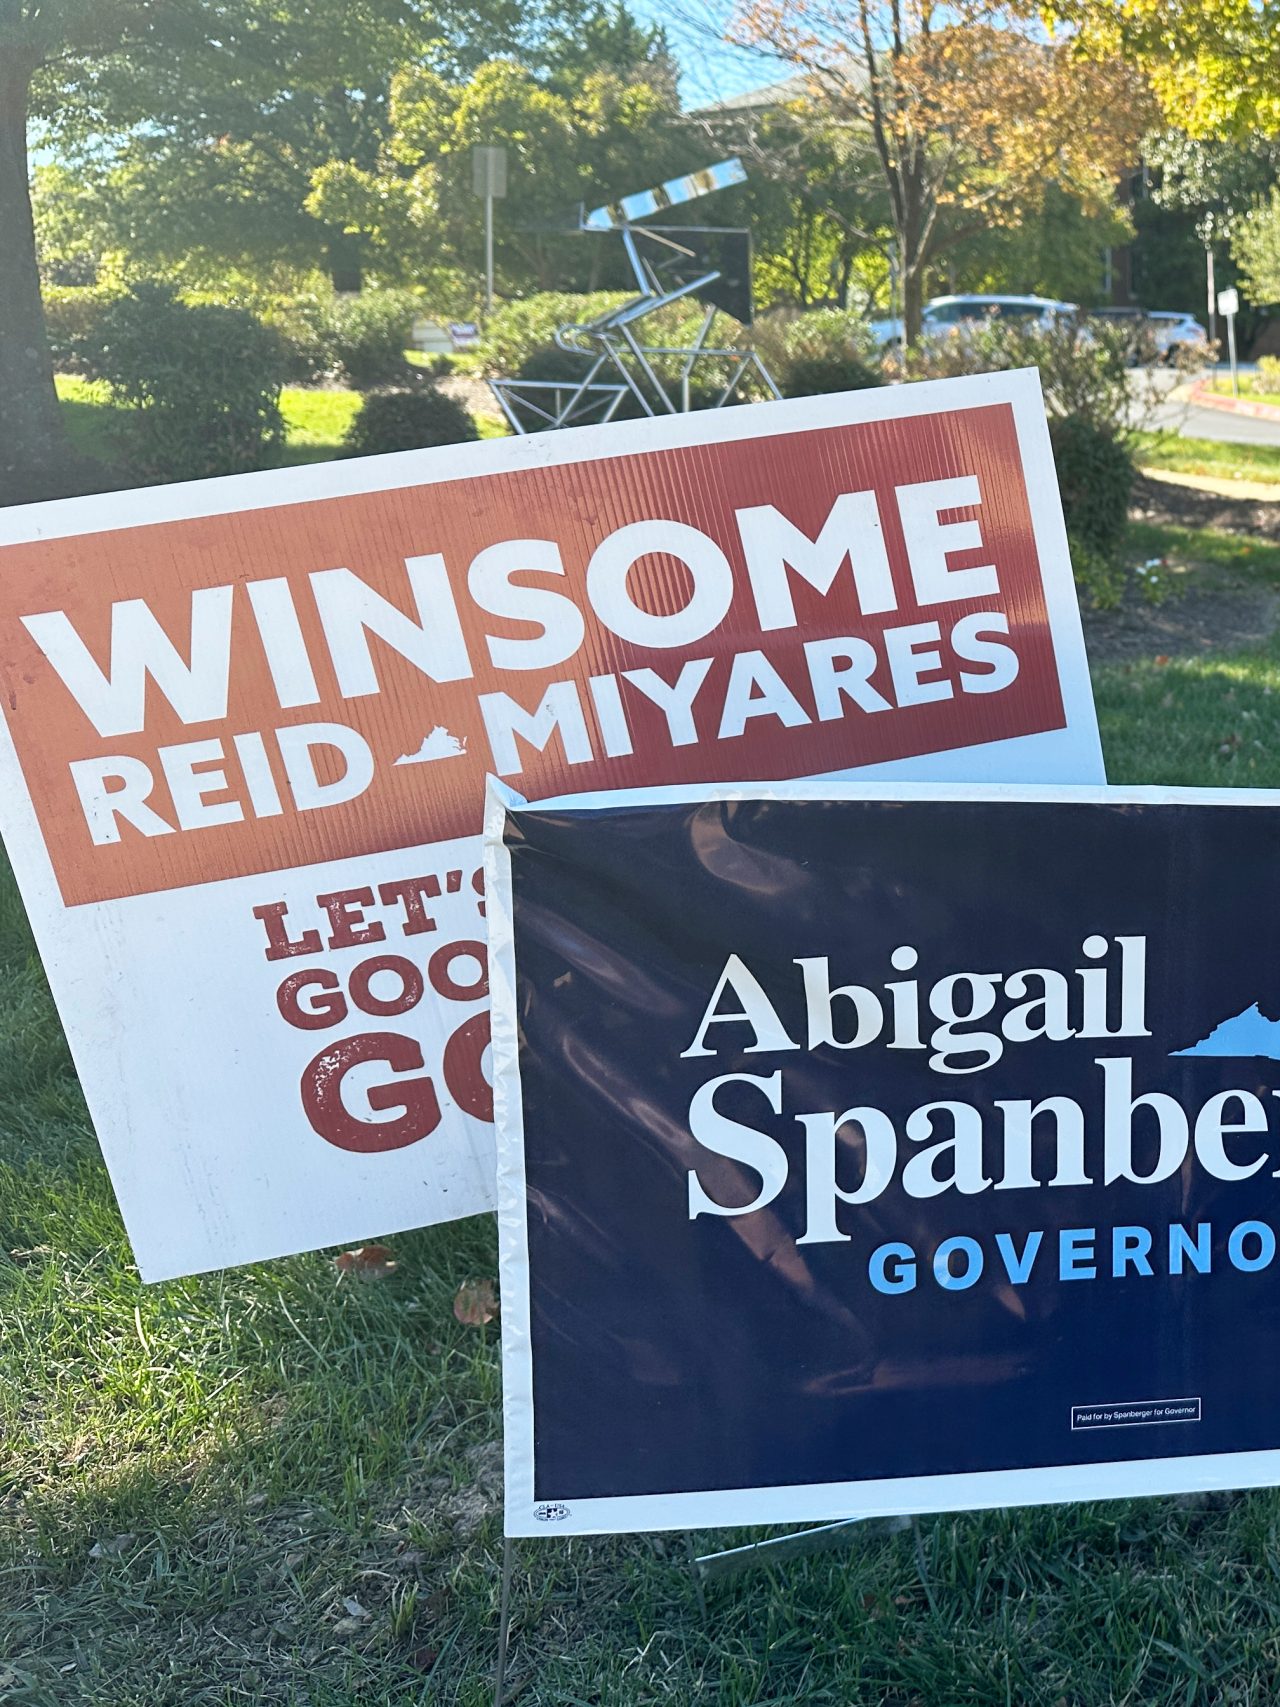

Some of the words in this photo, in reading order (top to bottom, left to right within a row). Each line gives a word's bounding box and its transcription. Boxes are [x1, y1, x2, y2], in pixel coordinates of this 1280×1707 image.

[19, 474, 1001, 738] WINSOME
[69, 721, 375, 847] REID
[477, 611, 1020, 776] MIYARES
[680, 935, 1153, 1074] Abigail
[1077, 1414, 1092, 1422] Paid
[1093, 1413, 1102, 1421] for
[1104, 1412, 1113, 1421] by
[1113, 1410, 1153, 1419] Spanberger
[1154, 1408, 1163, 1416] for
[1164, 1406, 1196, 1415] Governor
